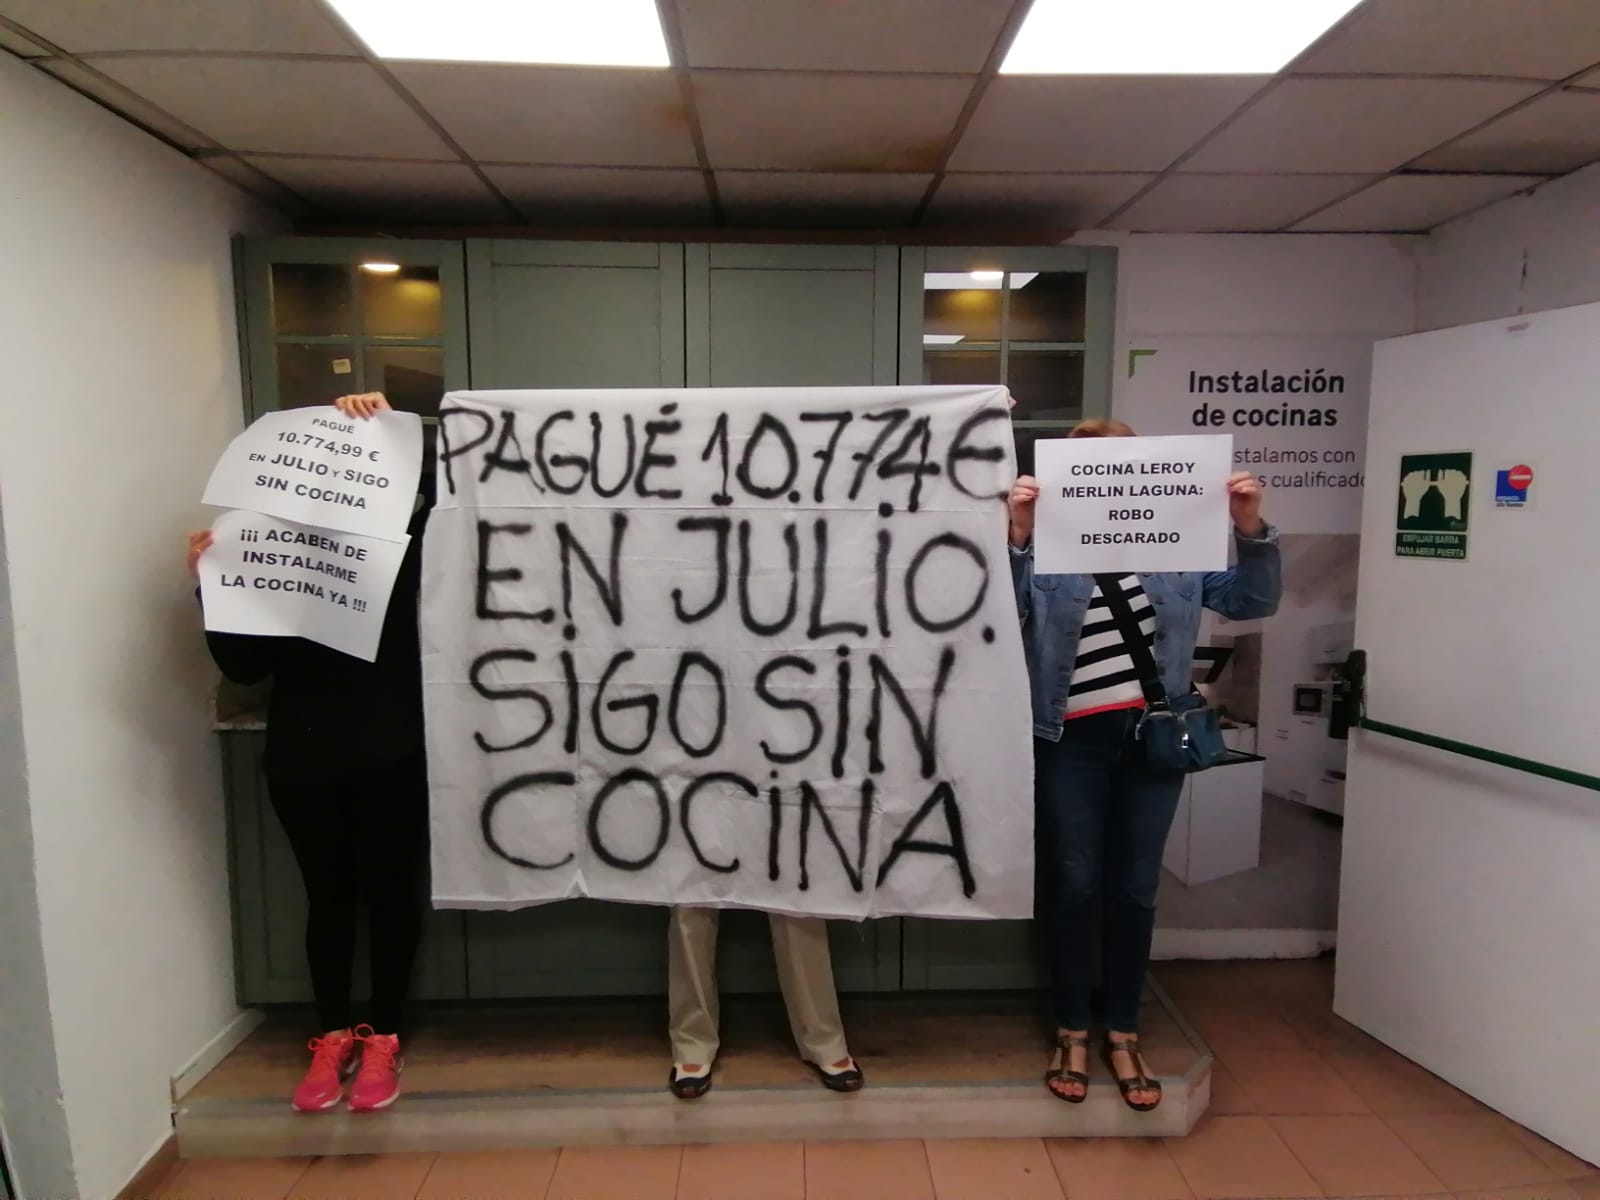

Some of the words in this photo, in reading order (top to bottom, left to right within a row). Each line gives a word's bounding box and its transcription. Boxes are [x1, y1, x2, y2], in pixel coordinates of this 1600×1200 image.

[1189, 368, 1344, 393] Instalación
[1192, 403, 1225, 426] de
[1232, 403, 1338, 426] cocinas
[277, 431, 362, 458] 10.774,99
[438, 402, 683, 496] PAGUÉ
[1234, 447, 1317, 463] stalamos
[1323, 450, 1355, 463] con
[249, 453, 265, 463] EN
[271, 453, 329, 476] JULIO
[332, 470, 340, 478] Y
[344, 469, 389, 489] SIGO
[1071, 463, 1133, 476] COCINA
[1141, 462, 1196, 474] LEROY
[255, 474, 288, 491] SIN
[295, 484, 366, 509] COCINA
[1062, 486, 1124, 498] MERLIN
[1130, 485, 1203, 497] LAGUNA:
[1109, 509, 1154, 521] ROBO
[265, 529, 339, 554] ACABEN
[344, 545, 367, 561] DE
[1081, 532, 1180, 545] DESCARADO
[243, 550, 357, 583] INSTALARME
[476, 512, 629, 625] EN
[221, 574, 245, 588] LA
[253, 577, 324, 598] COCINA
[329, 590, 348, 608] YA
[469, 626, 728, 758] SIGO
